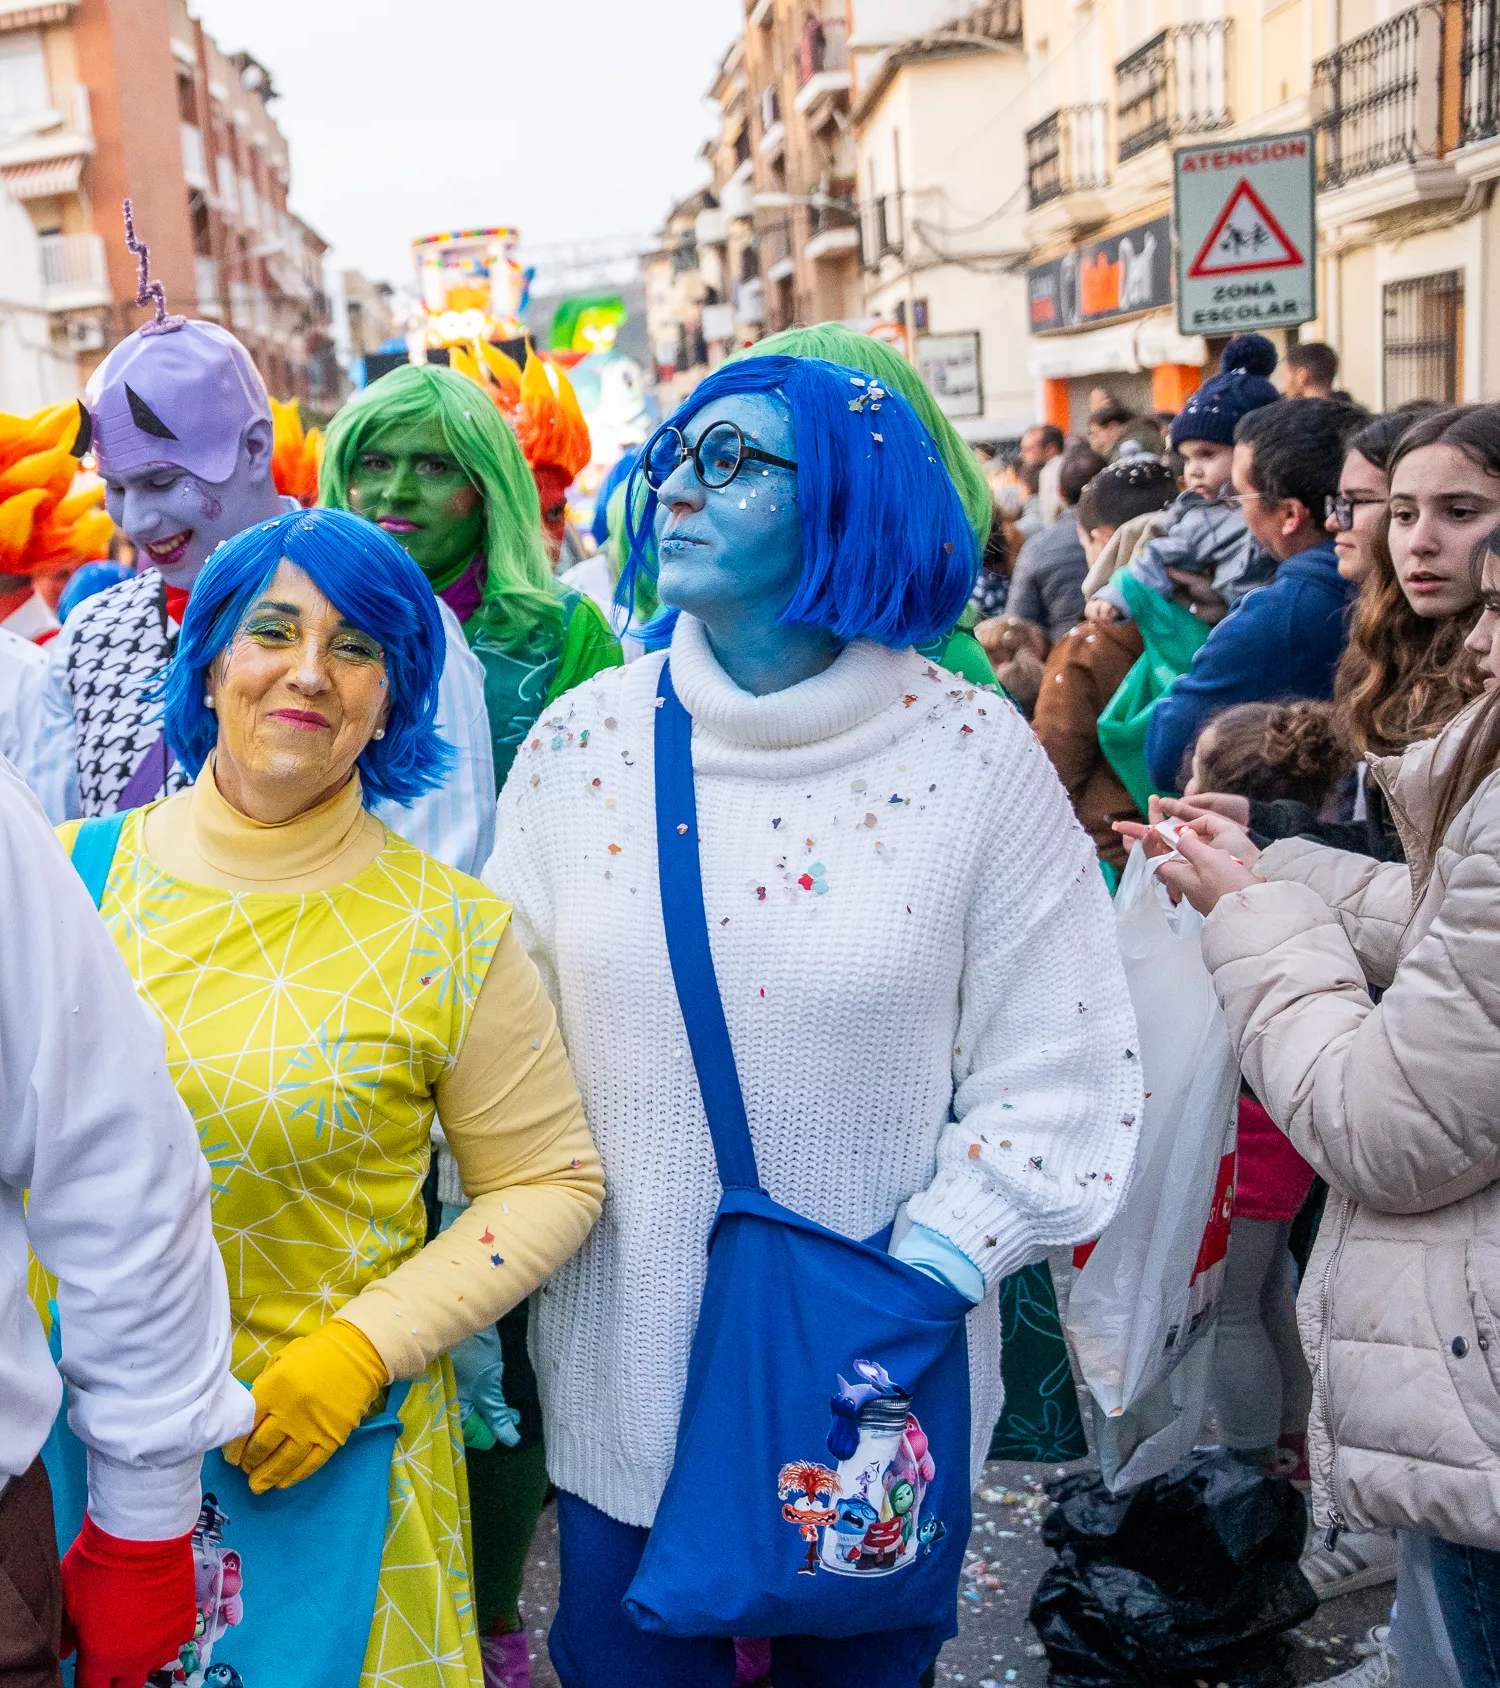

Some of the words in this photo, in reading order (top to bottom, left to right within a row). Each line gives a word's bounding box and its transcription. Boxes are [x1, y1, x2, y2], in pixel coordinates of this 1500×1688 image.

[1182, 141, 1306, 172] ATENCION
[1213, 281, 1275, 302] ZONA
[1193, 301, 1298, 324] ESCOLAR
